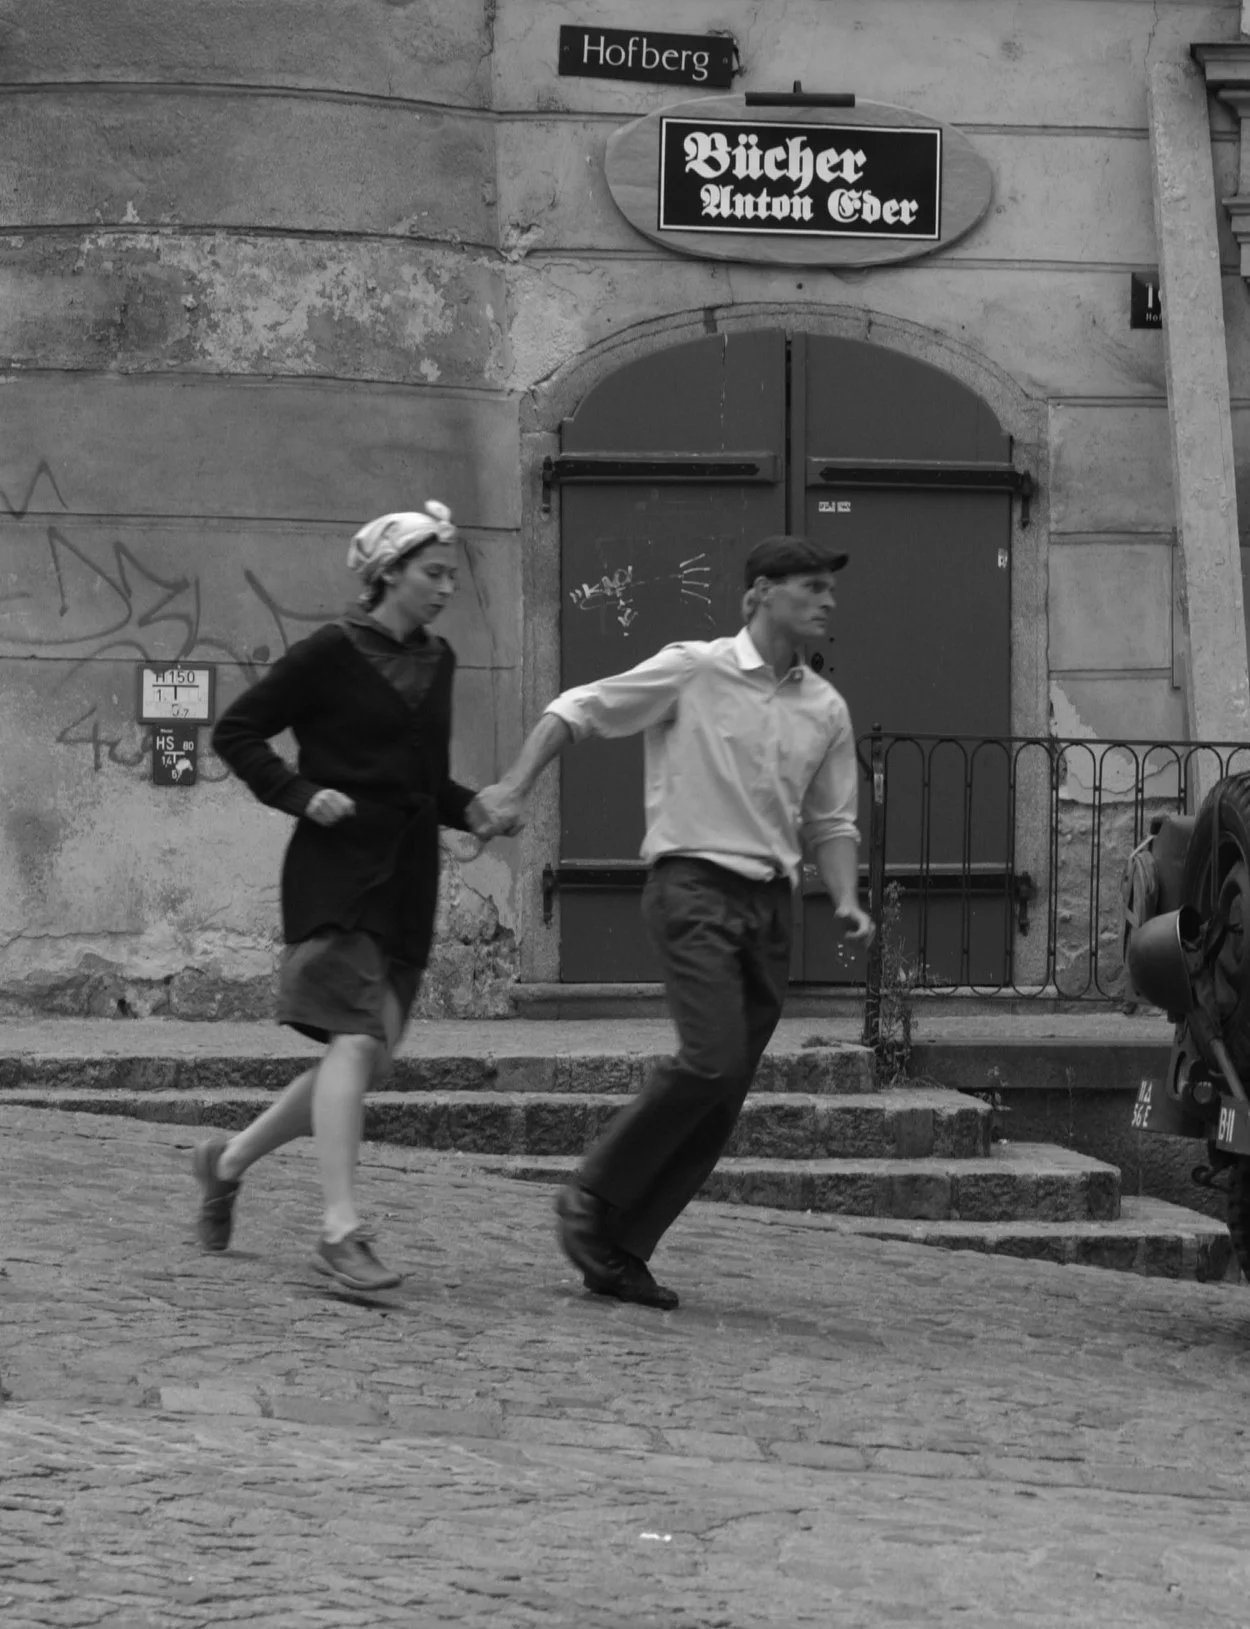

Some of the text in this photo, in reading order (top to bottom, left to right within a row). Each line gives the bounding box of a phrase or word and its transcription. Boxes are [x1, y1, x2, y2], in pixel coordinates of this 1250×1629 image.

[583, 35, 710, 81] Hofberg
[683, 131, 866, 191] Bücher
[700, 183, 919, 226] Anton Eder
[156, 736, 194, 751] HS 80
